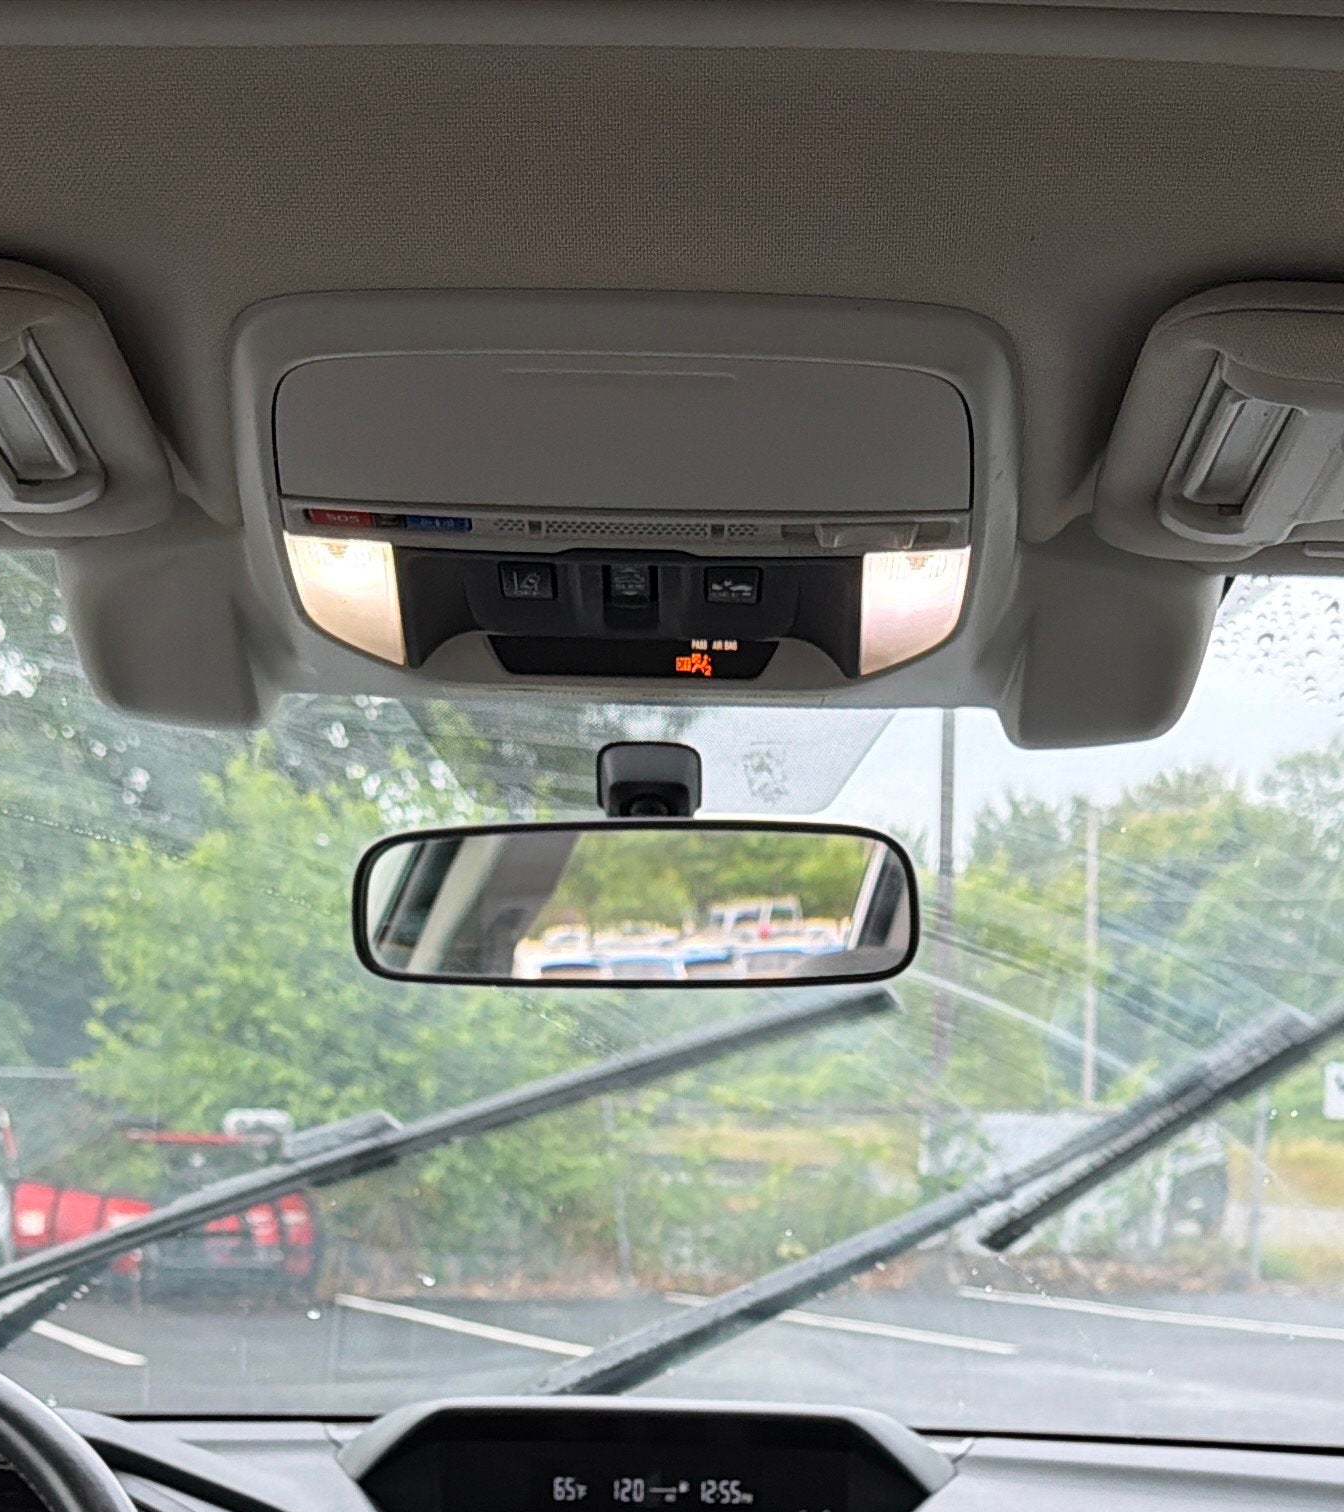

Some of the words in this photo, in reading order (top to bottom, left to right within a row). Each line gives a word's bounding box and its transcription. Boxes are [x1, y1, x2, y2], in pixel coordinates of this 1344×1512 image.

[325, 513, 360, 523] SOS
[691, 638, 708, 650] PASS
[612, 1477, 645, 1503] 120
